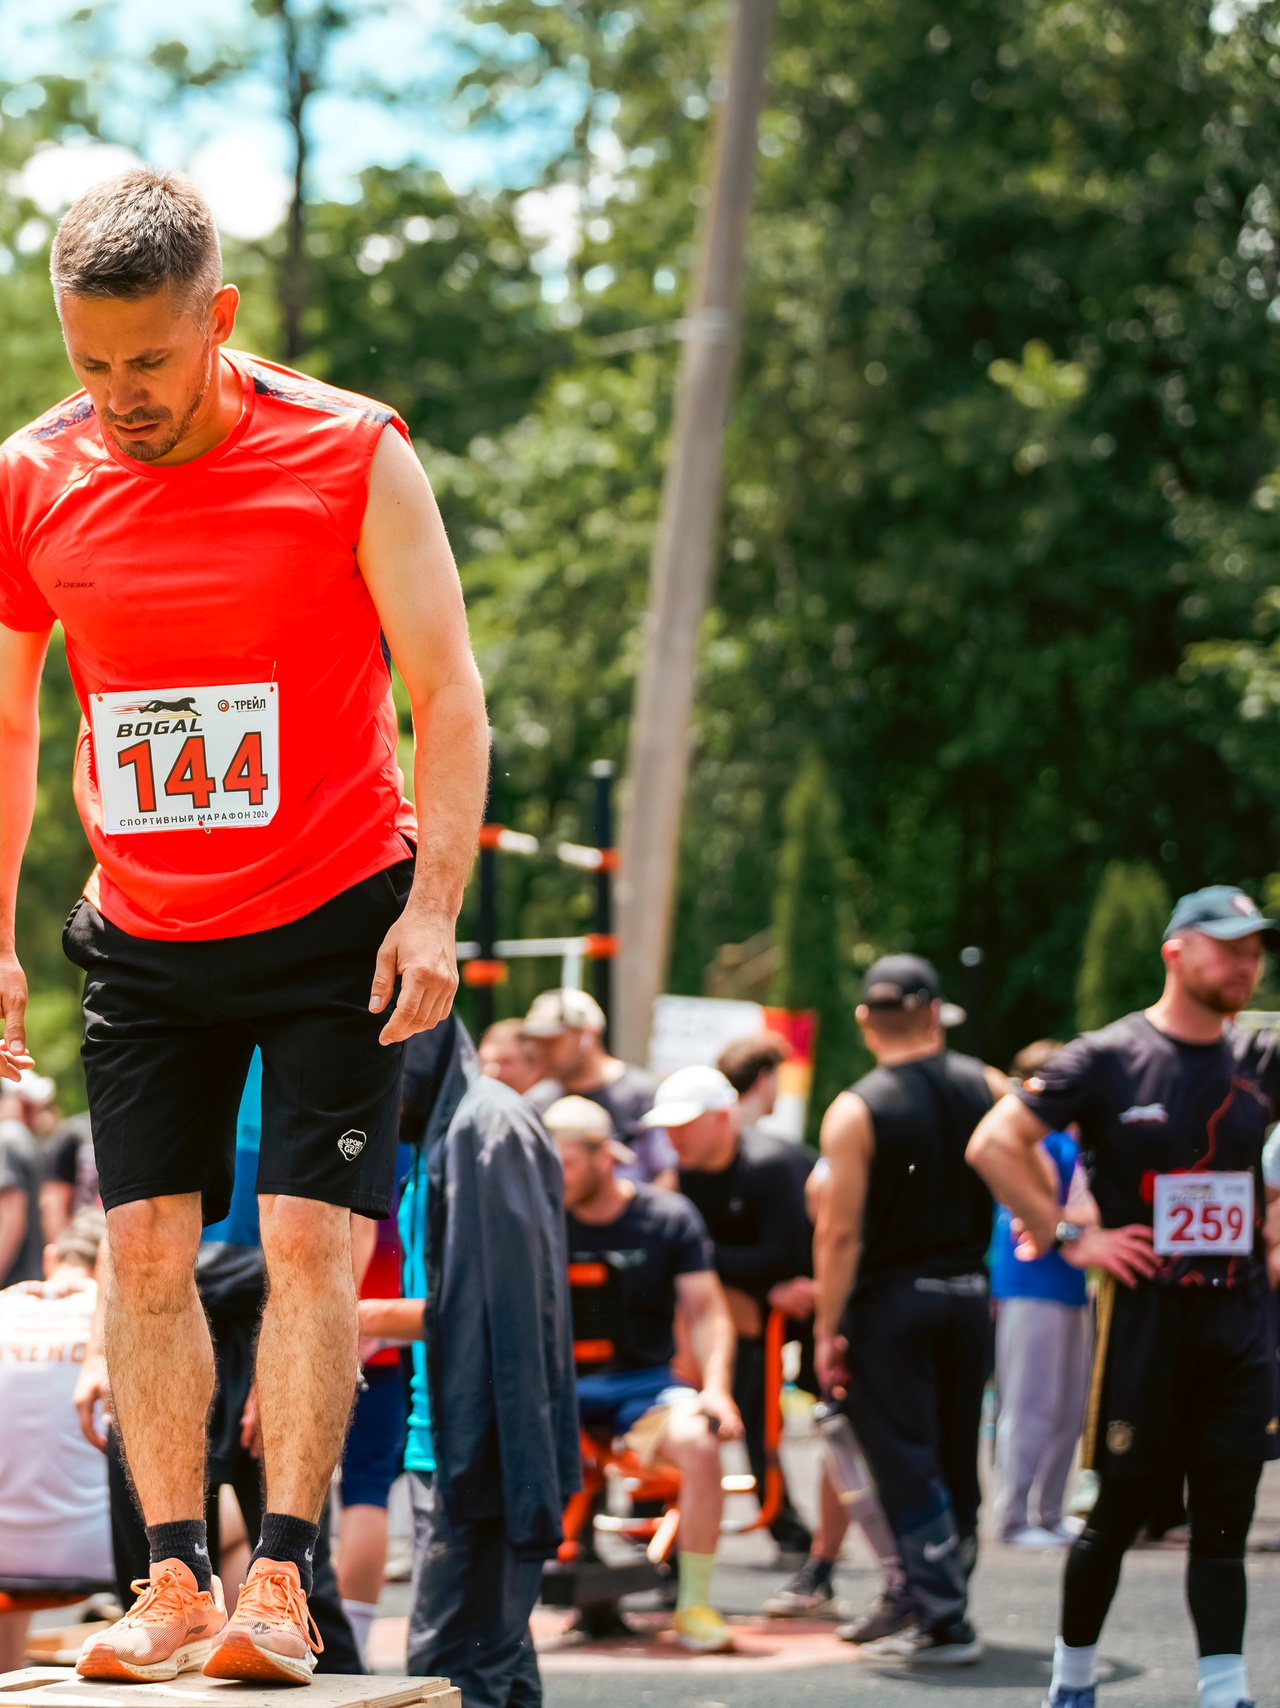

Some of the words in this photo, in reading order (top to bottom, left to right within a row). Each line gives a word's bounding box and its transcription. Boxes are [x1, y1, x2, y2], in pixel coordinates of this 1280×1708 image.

[116, 718, 203, 738] BOGAL
[117, 731, 269, 813] 144
[119, 813, 194, 827] СПОРТИВНЫЙ
[197, 811, 251, 823] МАРАФОН
[1169, 1205, 1243, 1242] 259
